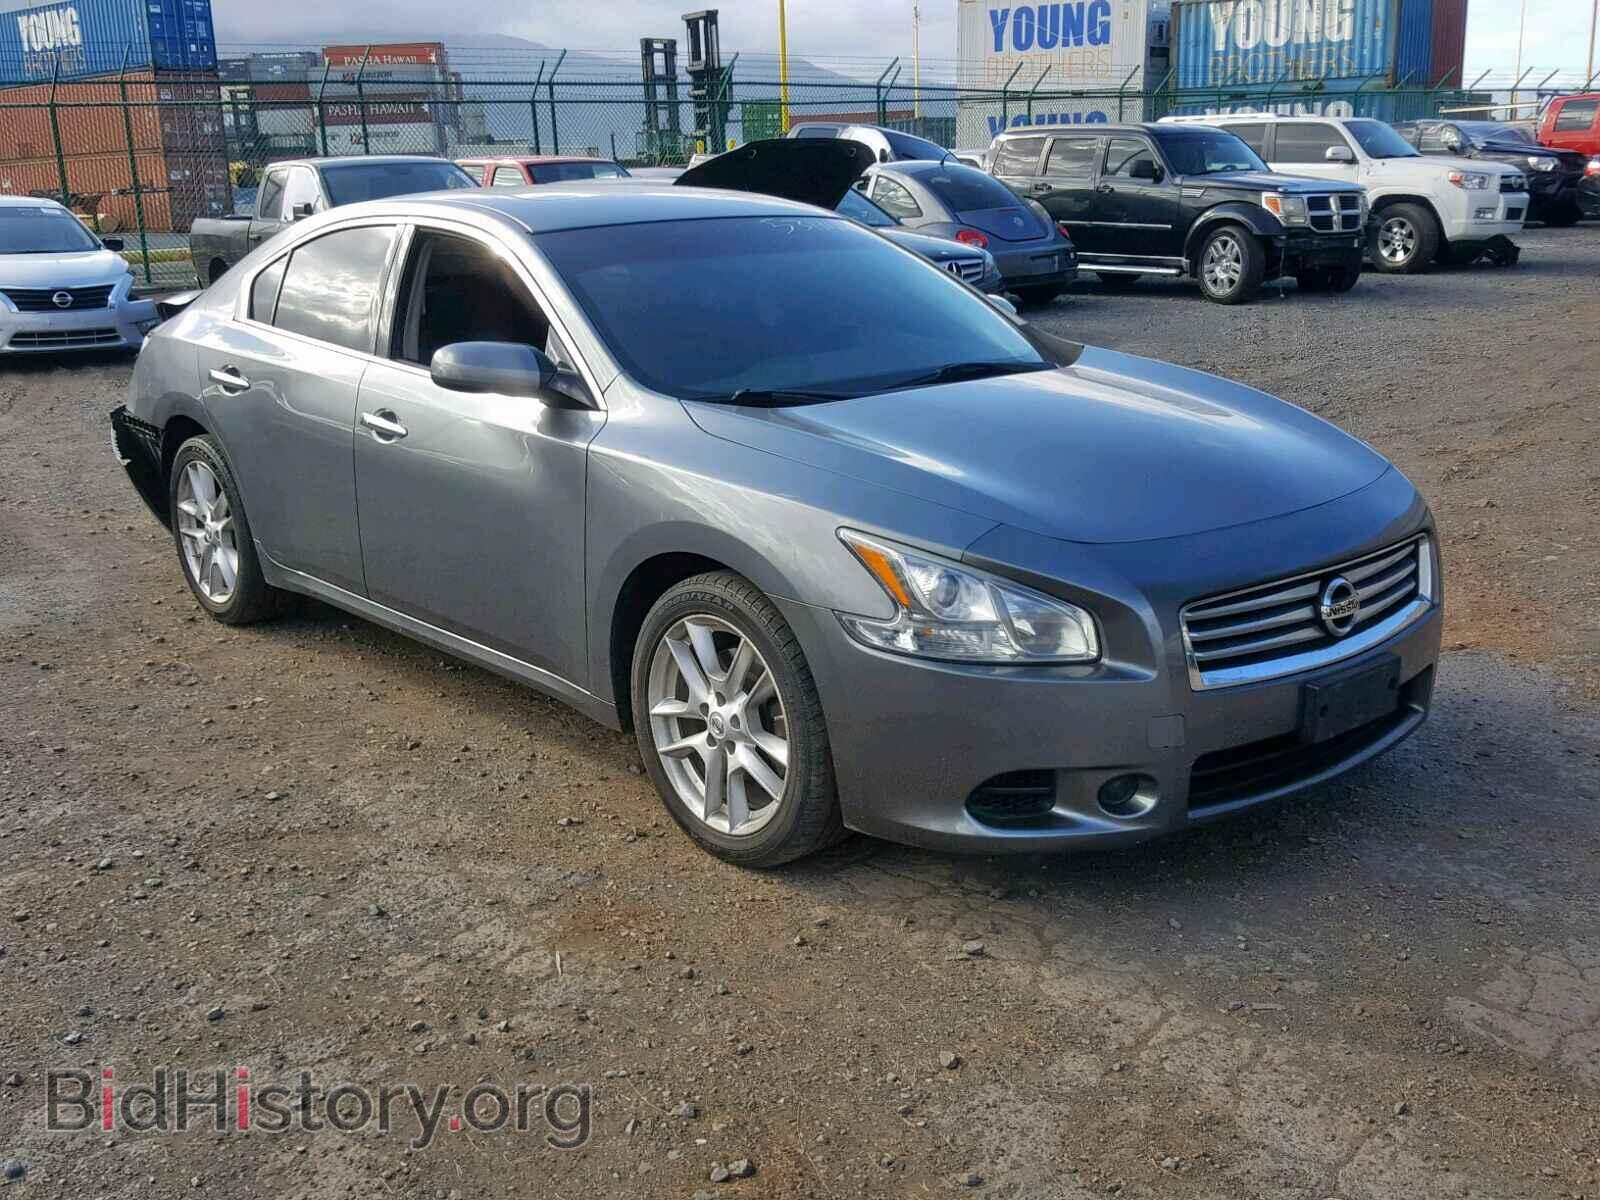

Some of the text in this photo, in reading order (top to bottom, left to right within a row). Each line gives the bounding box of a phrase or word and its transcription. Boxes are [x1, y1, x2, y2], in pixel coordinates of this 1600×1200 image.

[17, 7, 81, 52] YOUNG
[989, 0, 1111, 52] YOUNG
[1209, 0, 1354, 51] YOUNG
[383, 55, 417, 65] HAWAII
[369, 102, 416, 115] HAWAII
[1326, 599, 1359, 617] NISSAN
